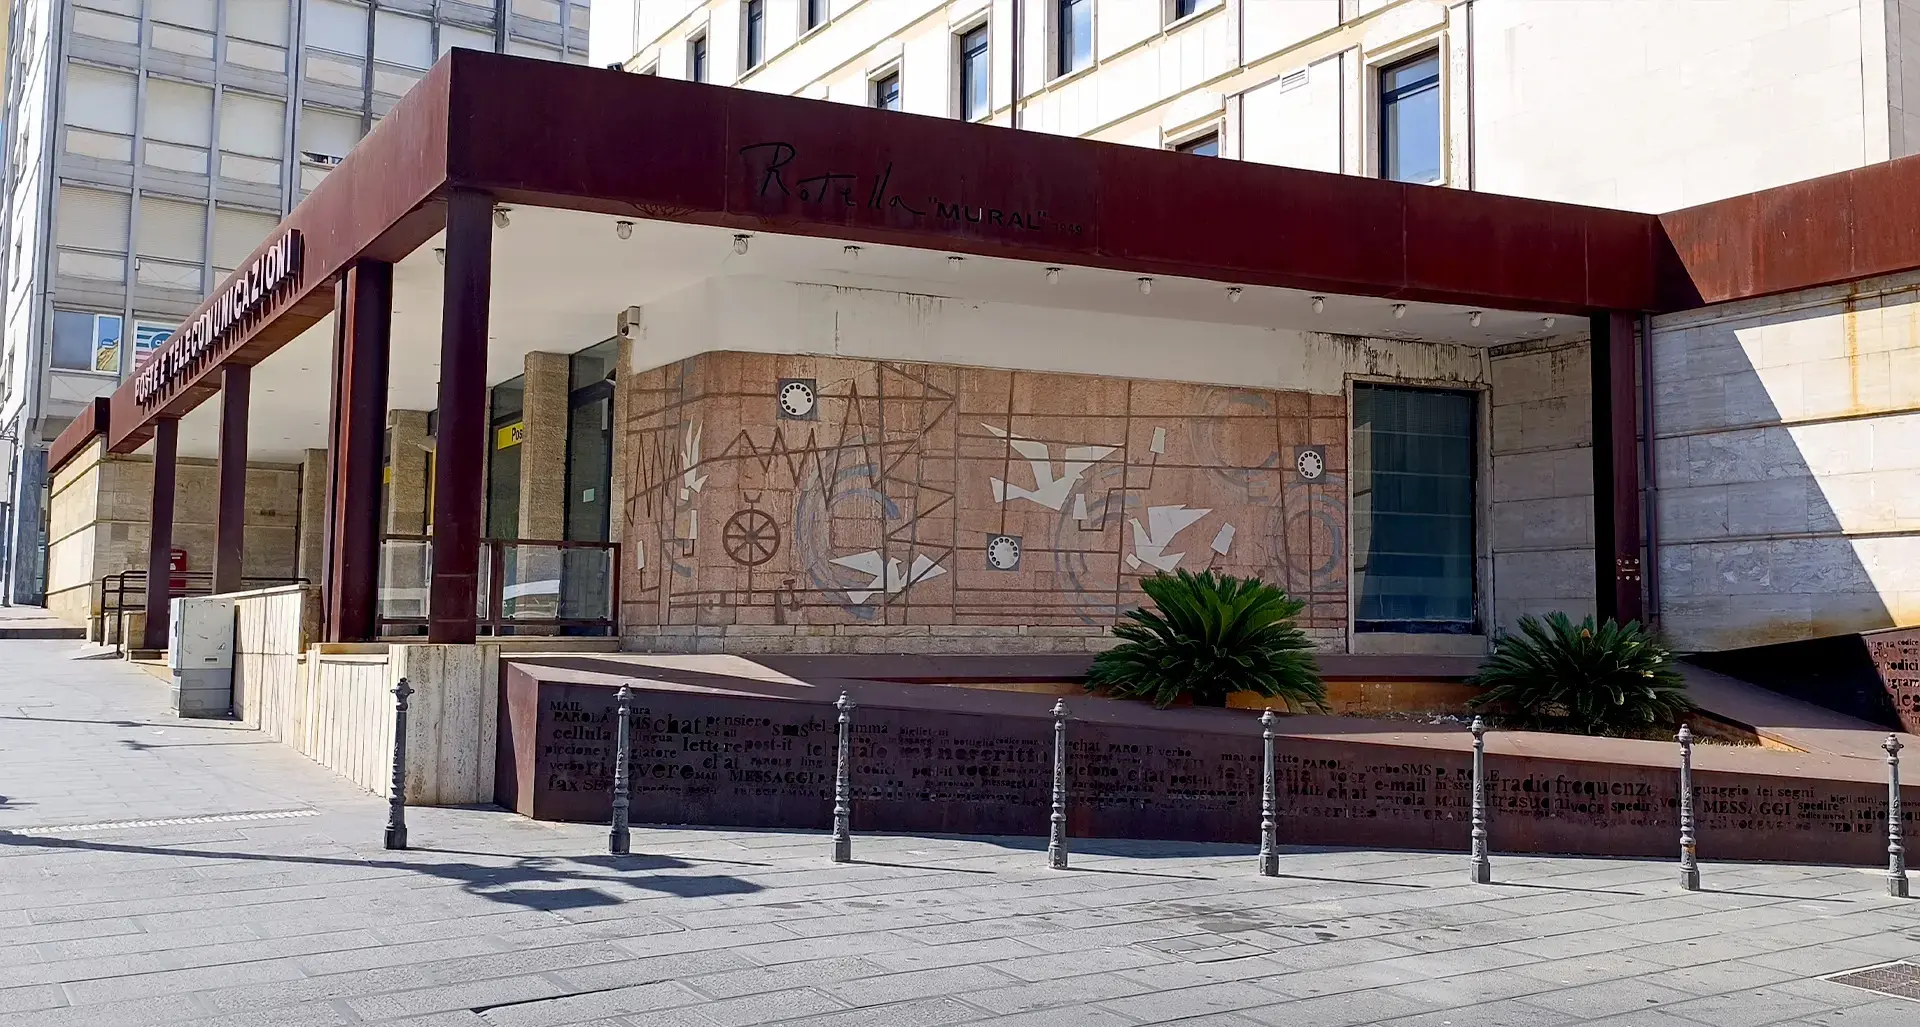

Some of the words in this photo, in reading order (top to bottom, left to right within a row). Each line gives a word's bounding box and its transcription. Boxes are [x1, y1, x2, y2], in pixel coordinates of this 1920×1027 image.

[928, 196, 1048, 232] "MURAL"
[168, 228, 300, 378] TELECOMUNICAZIONI
[549, 701, 583, 712] MAIL
[553, 712, 609, 724] PAROLA
[653, 713, 702, 735] chat
[772, 723, 809, 738] sms
[1108, 743, 1154, 755] PAROE
[729, 768, 815, 785] MESSAGGI
[1066, 763, 1119, 778] elefono
[1401, 763, 1432, 777] SMS
[548, 773, 579, 792] fax
[1375, 777, 1427, 792] e-mail
[1777, 786, 1814, 801] segni
[1829, 794, 1877, 806] biglittini
[1797, 800, 1840, 812] spedire
